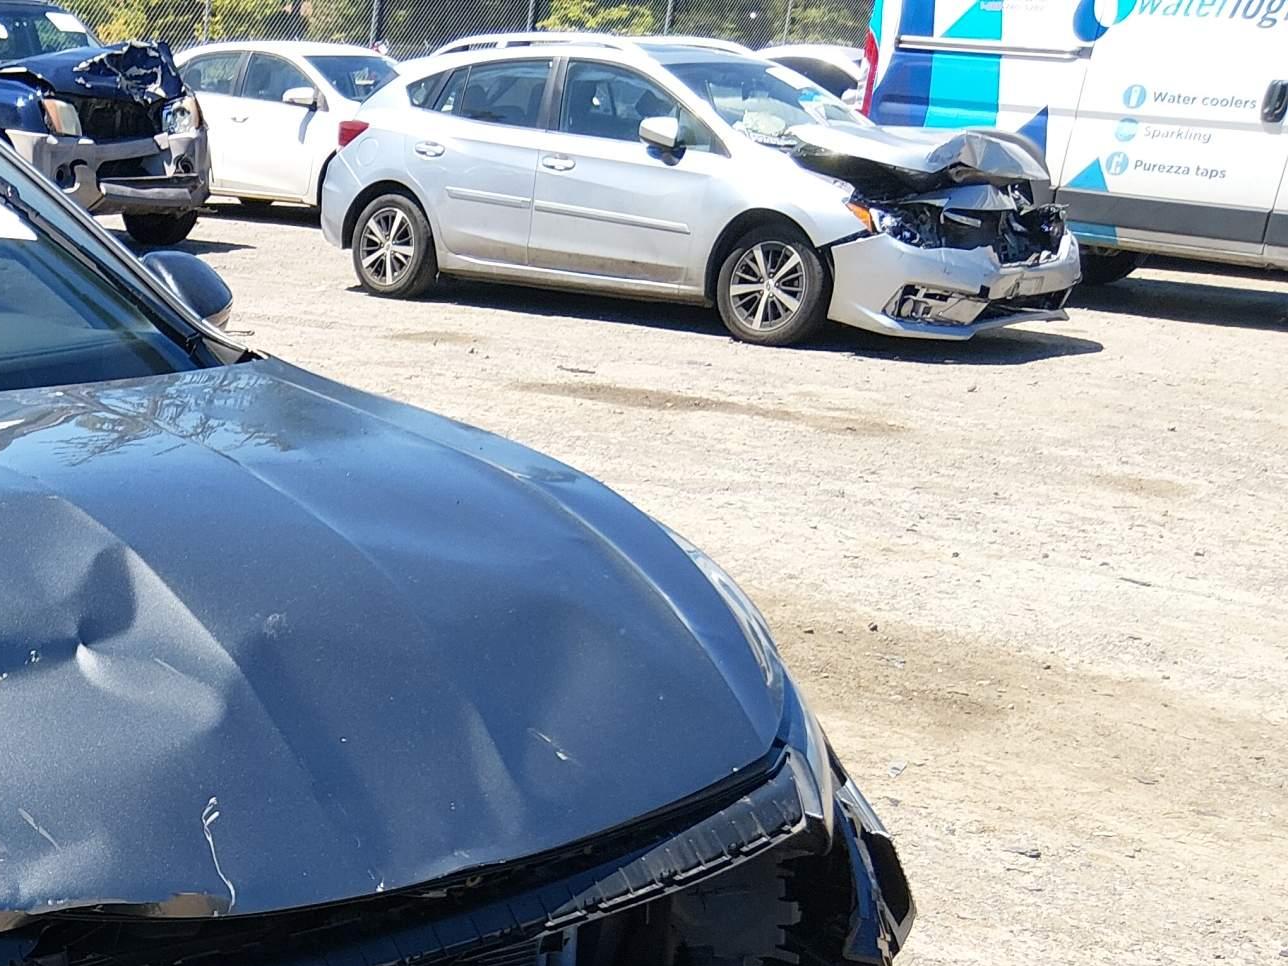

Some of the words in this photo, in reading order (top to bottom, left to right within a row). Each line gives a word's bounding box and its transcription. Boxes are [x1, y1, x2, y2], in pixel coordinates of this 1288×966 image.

[1153, 91, 1197, 105] Water
[1202, 96, 1257, 109] coolers
[1144, 126, 1212, 144] Sparkling
[1134, 159, 1190, 175] Purezza
[1195, 165, 1227, 179] taps
